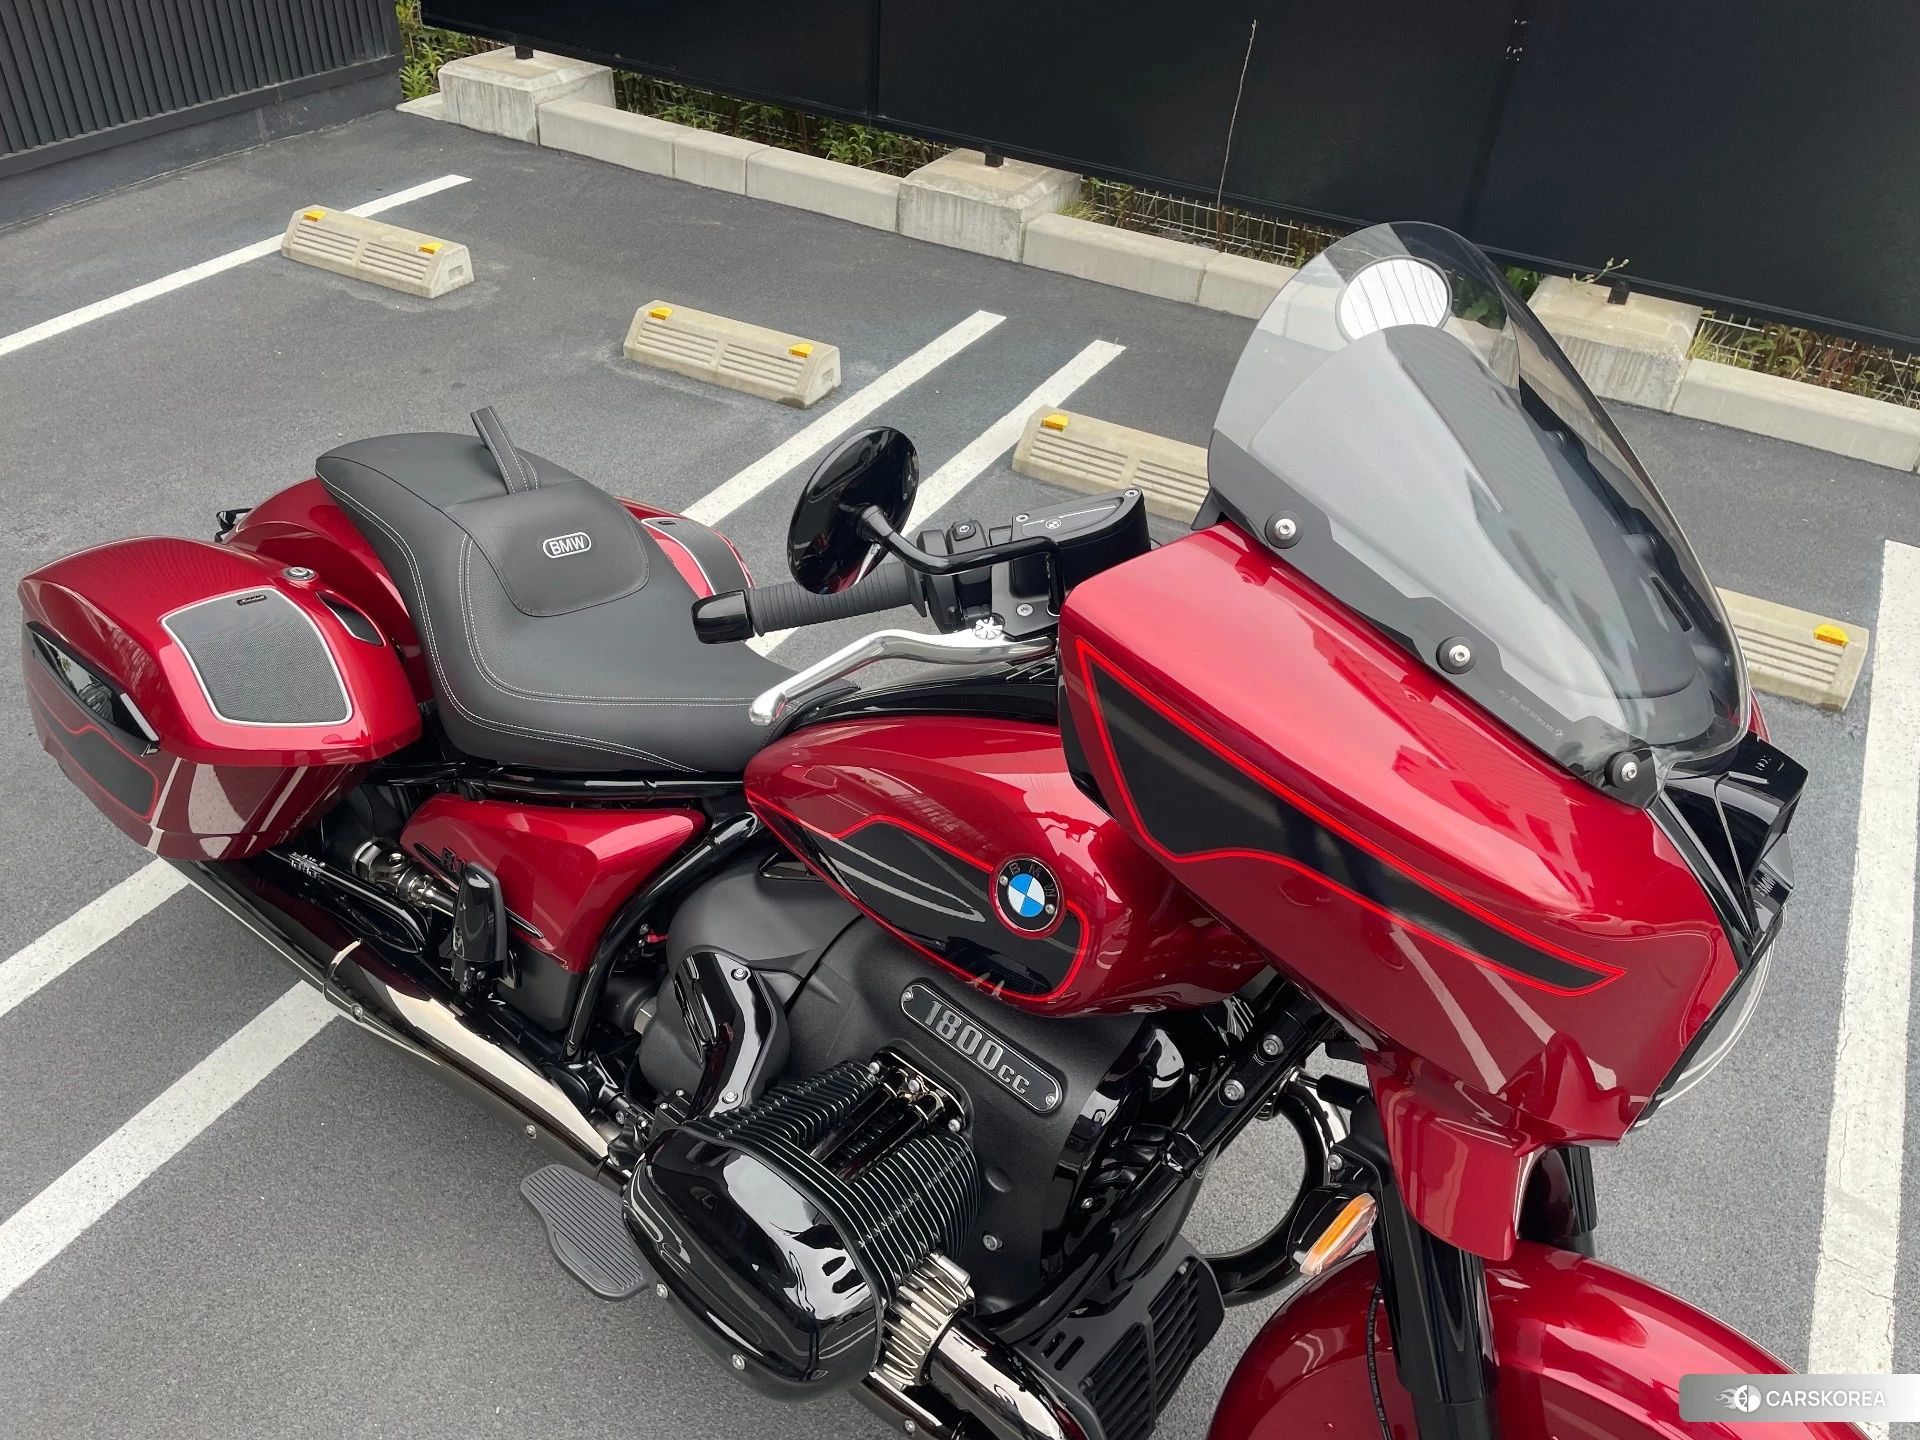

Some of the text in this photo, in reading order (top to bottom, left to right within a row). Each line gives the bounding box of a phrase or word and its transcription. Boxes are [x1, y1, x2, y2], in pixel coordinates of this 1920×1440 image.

[549, 535, 585, 555] BMW
[1009, 862, 1056, 897] BMW
[924, 1000, 1030, 1094] 1800cc
